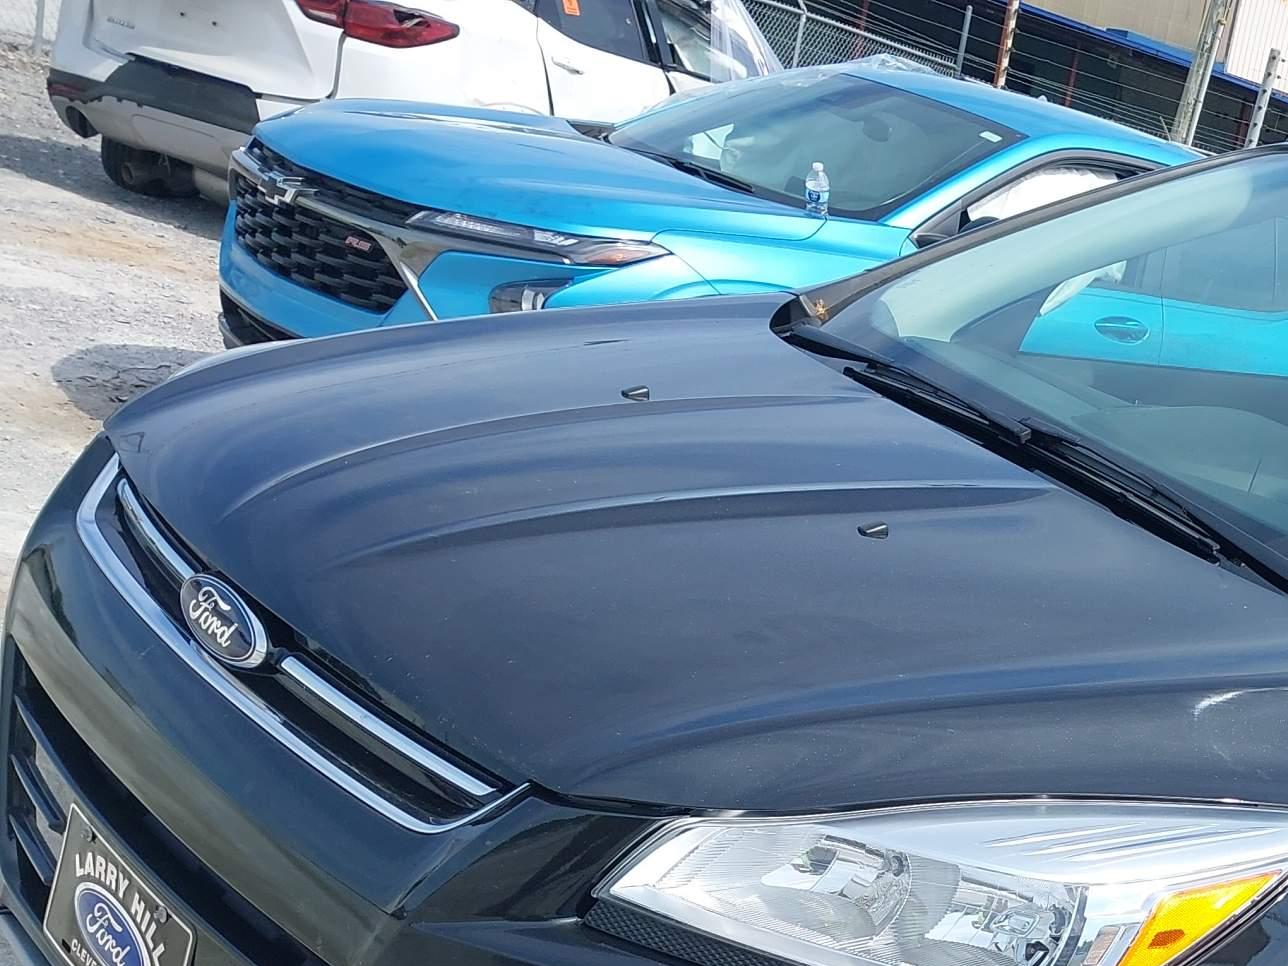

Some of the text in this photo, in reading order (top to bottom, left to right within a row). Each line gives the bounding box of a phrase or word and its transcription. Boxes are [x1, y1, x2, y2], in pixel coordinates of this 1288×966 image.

[344, 235, 371, 251] RS
[189, 586, 239, 648] Ford
[75, 852, 130, 900] LARRY
